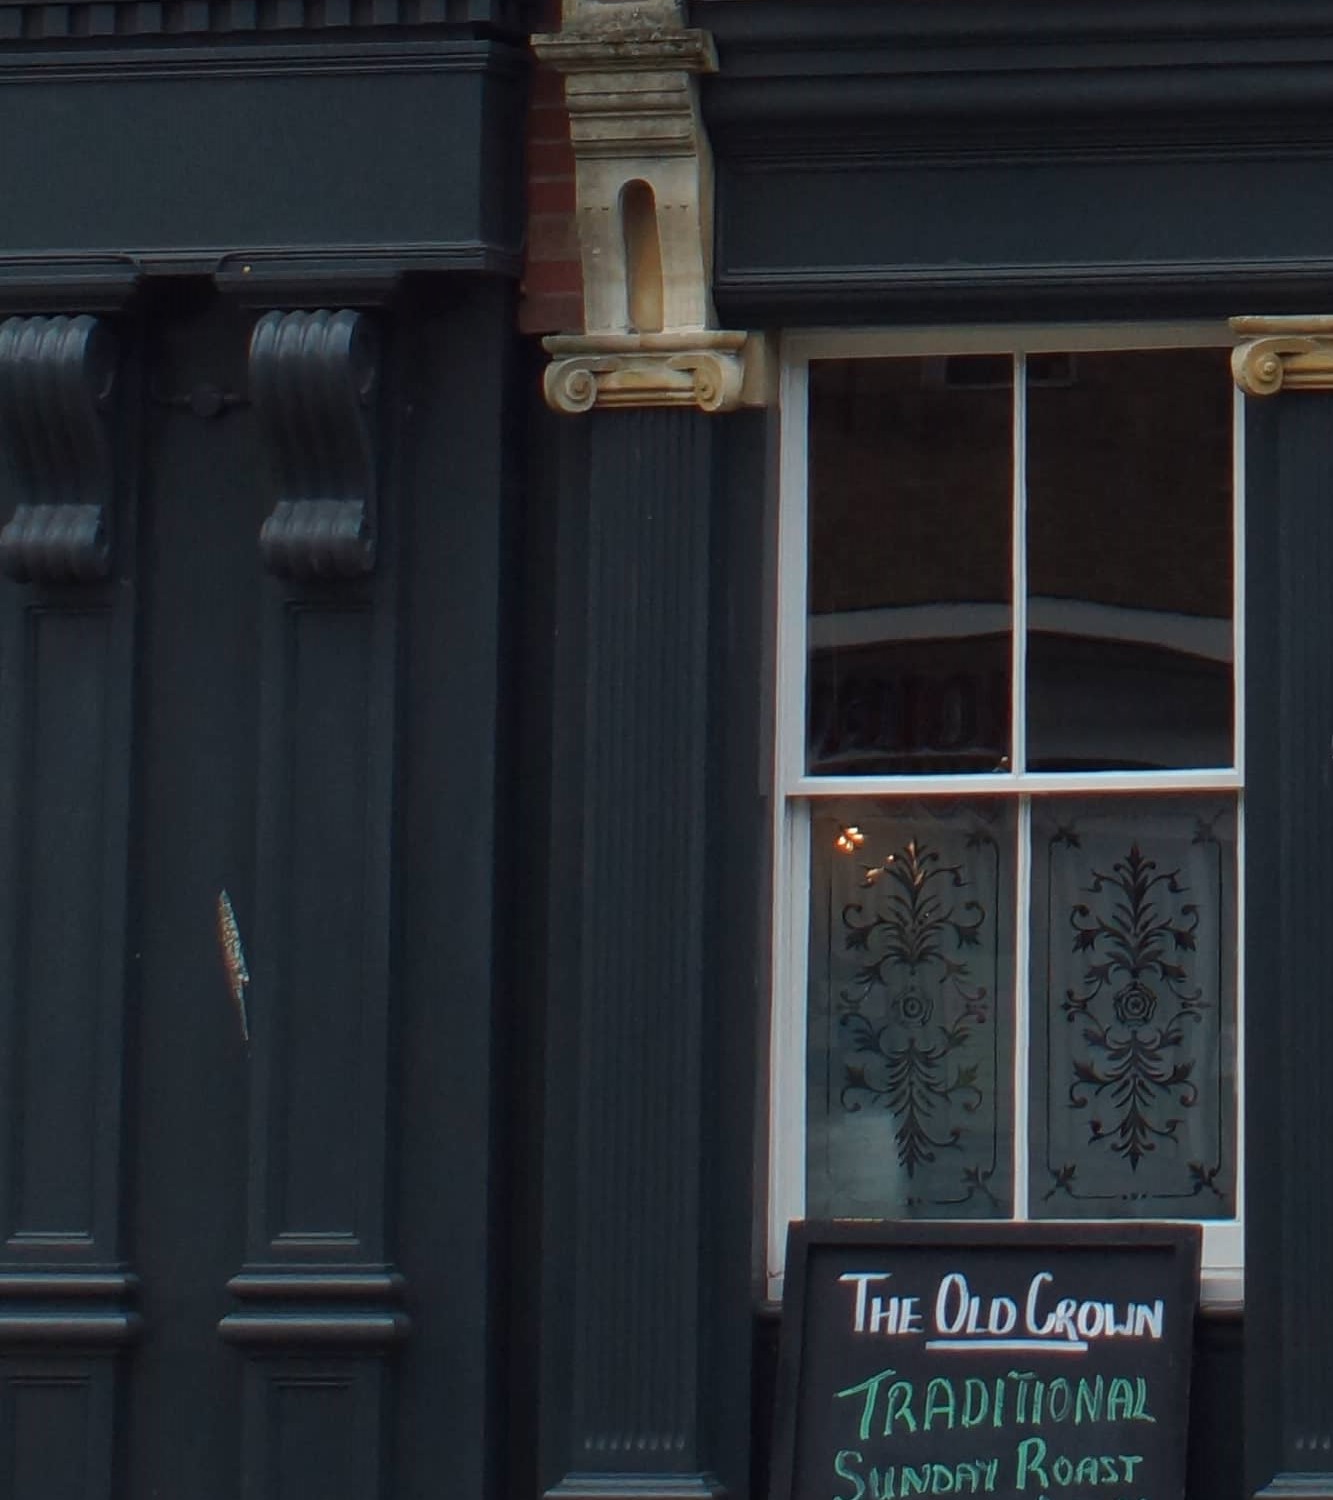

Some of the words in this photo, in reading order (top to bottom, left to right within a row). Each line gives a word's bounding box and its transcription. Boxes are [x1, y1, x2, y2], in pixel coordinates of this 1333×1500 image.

[837, 1271, 925, 1335] THE
[934, 1271, 1017, 1335] OLD
[1025, 1271, 1164, 1342] CROWN
[833, 1368, 1158, 1441] TRADITIONAL
[833, 1449, 999, 1500] SUNDAY
[1015, 1437, 1144, 1491] ROAST
